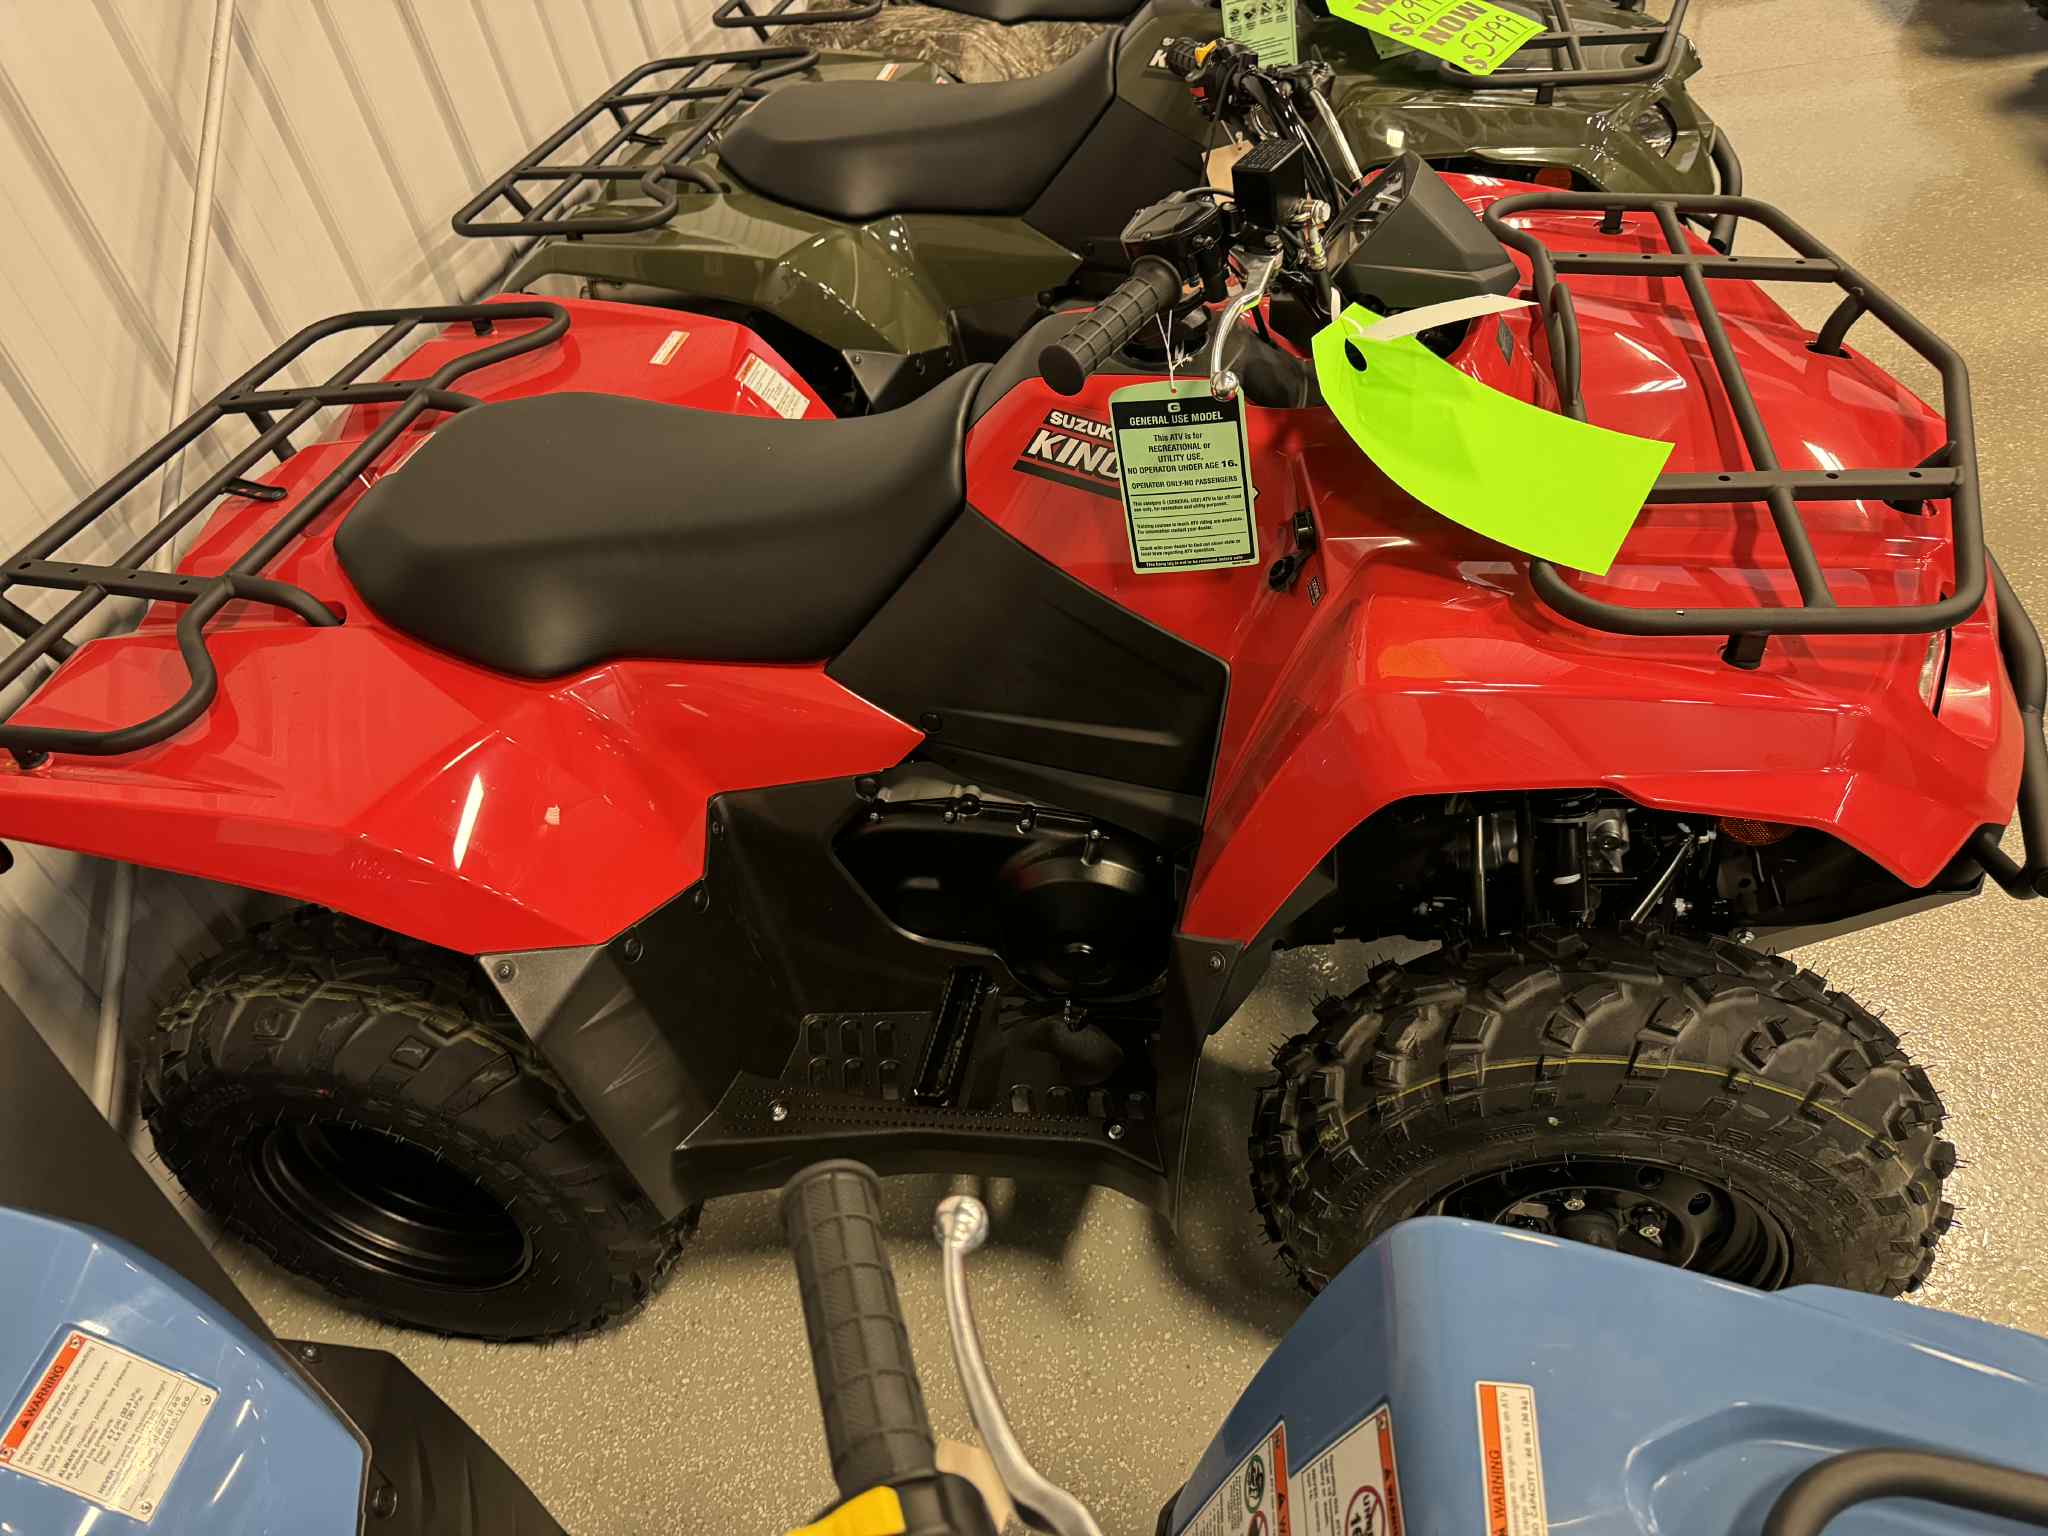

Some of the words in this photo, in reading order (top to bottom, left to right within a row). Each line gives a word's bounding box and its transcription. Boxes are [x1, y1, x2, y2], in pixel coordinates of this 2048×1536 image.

[1420, 1, 1488, 46] NOW
[1130, 416, 1169, 425] GENERAL
[1172, 414, 1189, 423] USE
[1191, 411, 1223, 422] MODEL
[1168, 403, 1181, 412] G
[1049, 411, 1113, 440] SUZUK
[1149, 444, 1201, 452] RECREATIONAL
[1158, 454, 1184, 463] UTILITY
[1187, 453, 1203, 461] USE.
[1140, 465, 1176, 474] OPERATOR
[1132, 481, 1165, 489] OPERATOR
[1167, 479, 1193, 487] ONLY-NO
[1195, 476, 1237, 485] PASSENGERS
[26, 1365, 65, 1417] WARNING
[57, 1447, 79, 1478] ALWAYS
[98, 1469, 116, 1494] NEVER
[1489, 1450, 1505, 1519] WARNING
[1527, 1470, 1538, 1518] CAPACITY
